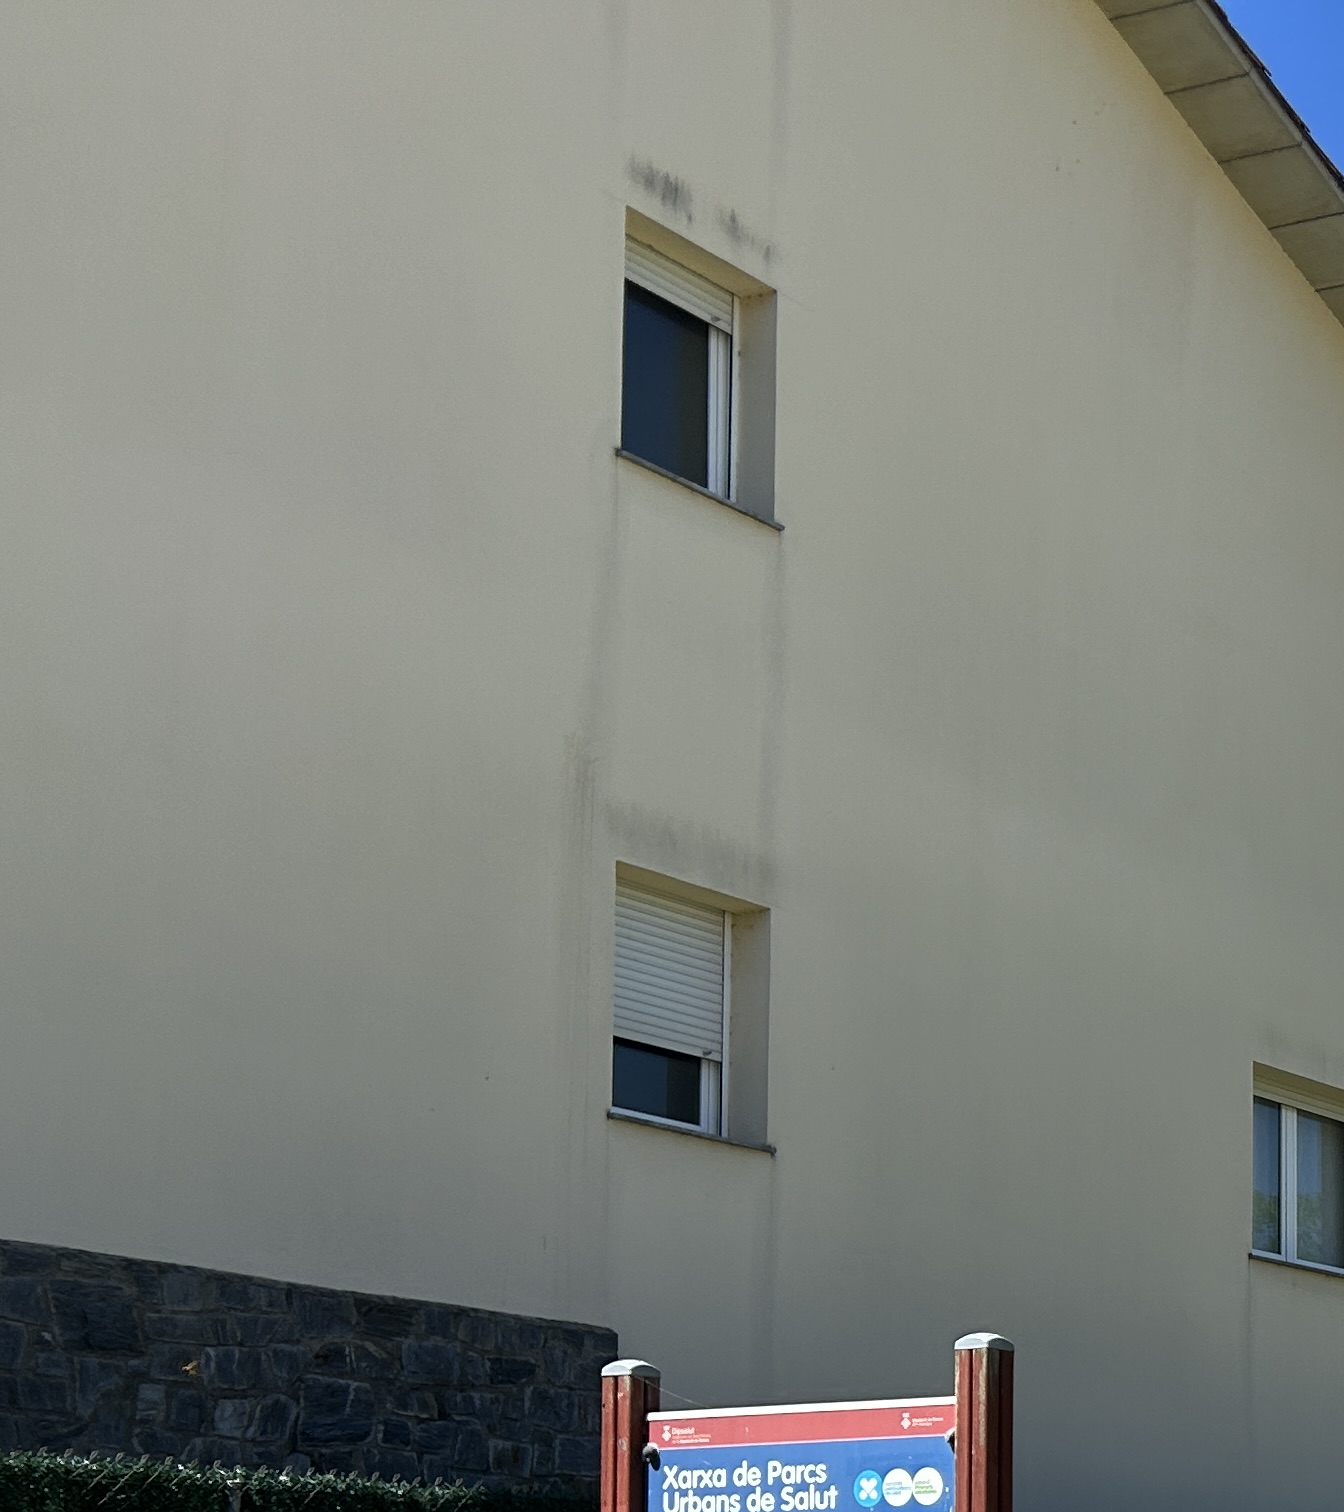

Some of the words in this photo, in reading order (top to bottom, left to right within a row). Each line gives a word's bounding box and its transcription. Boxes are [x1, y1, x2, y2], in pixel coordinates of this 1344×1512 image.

[662, 1465, 727, 1490] Xarxa
[733, 1460, 761, 1487] de
[767, 1460, 828, 1486] Parcs
[746, 1486, 775, 1512] de
[780, 1484, 839, 1512] Salut
